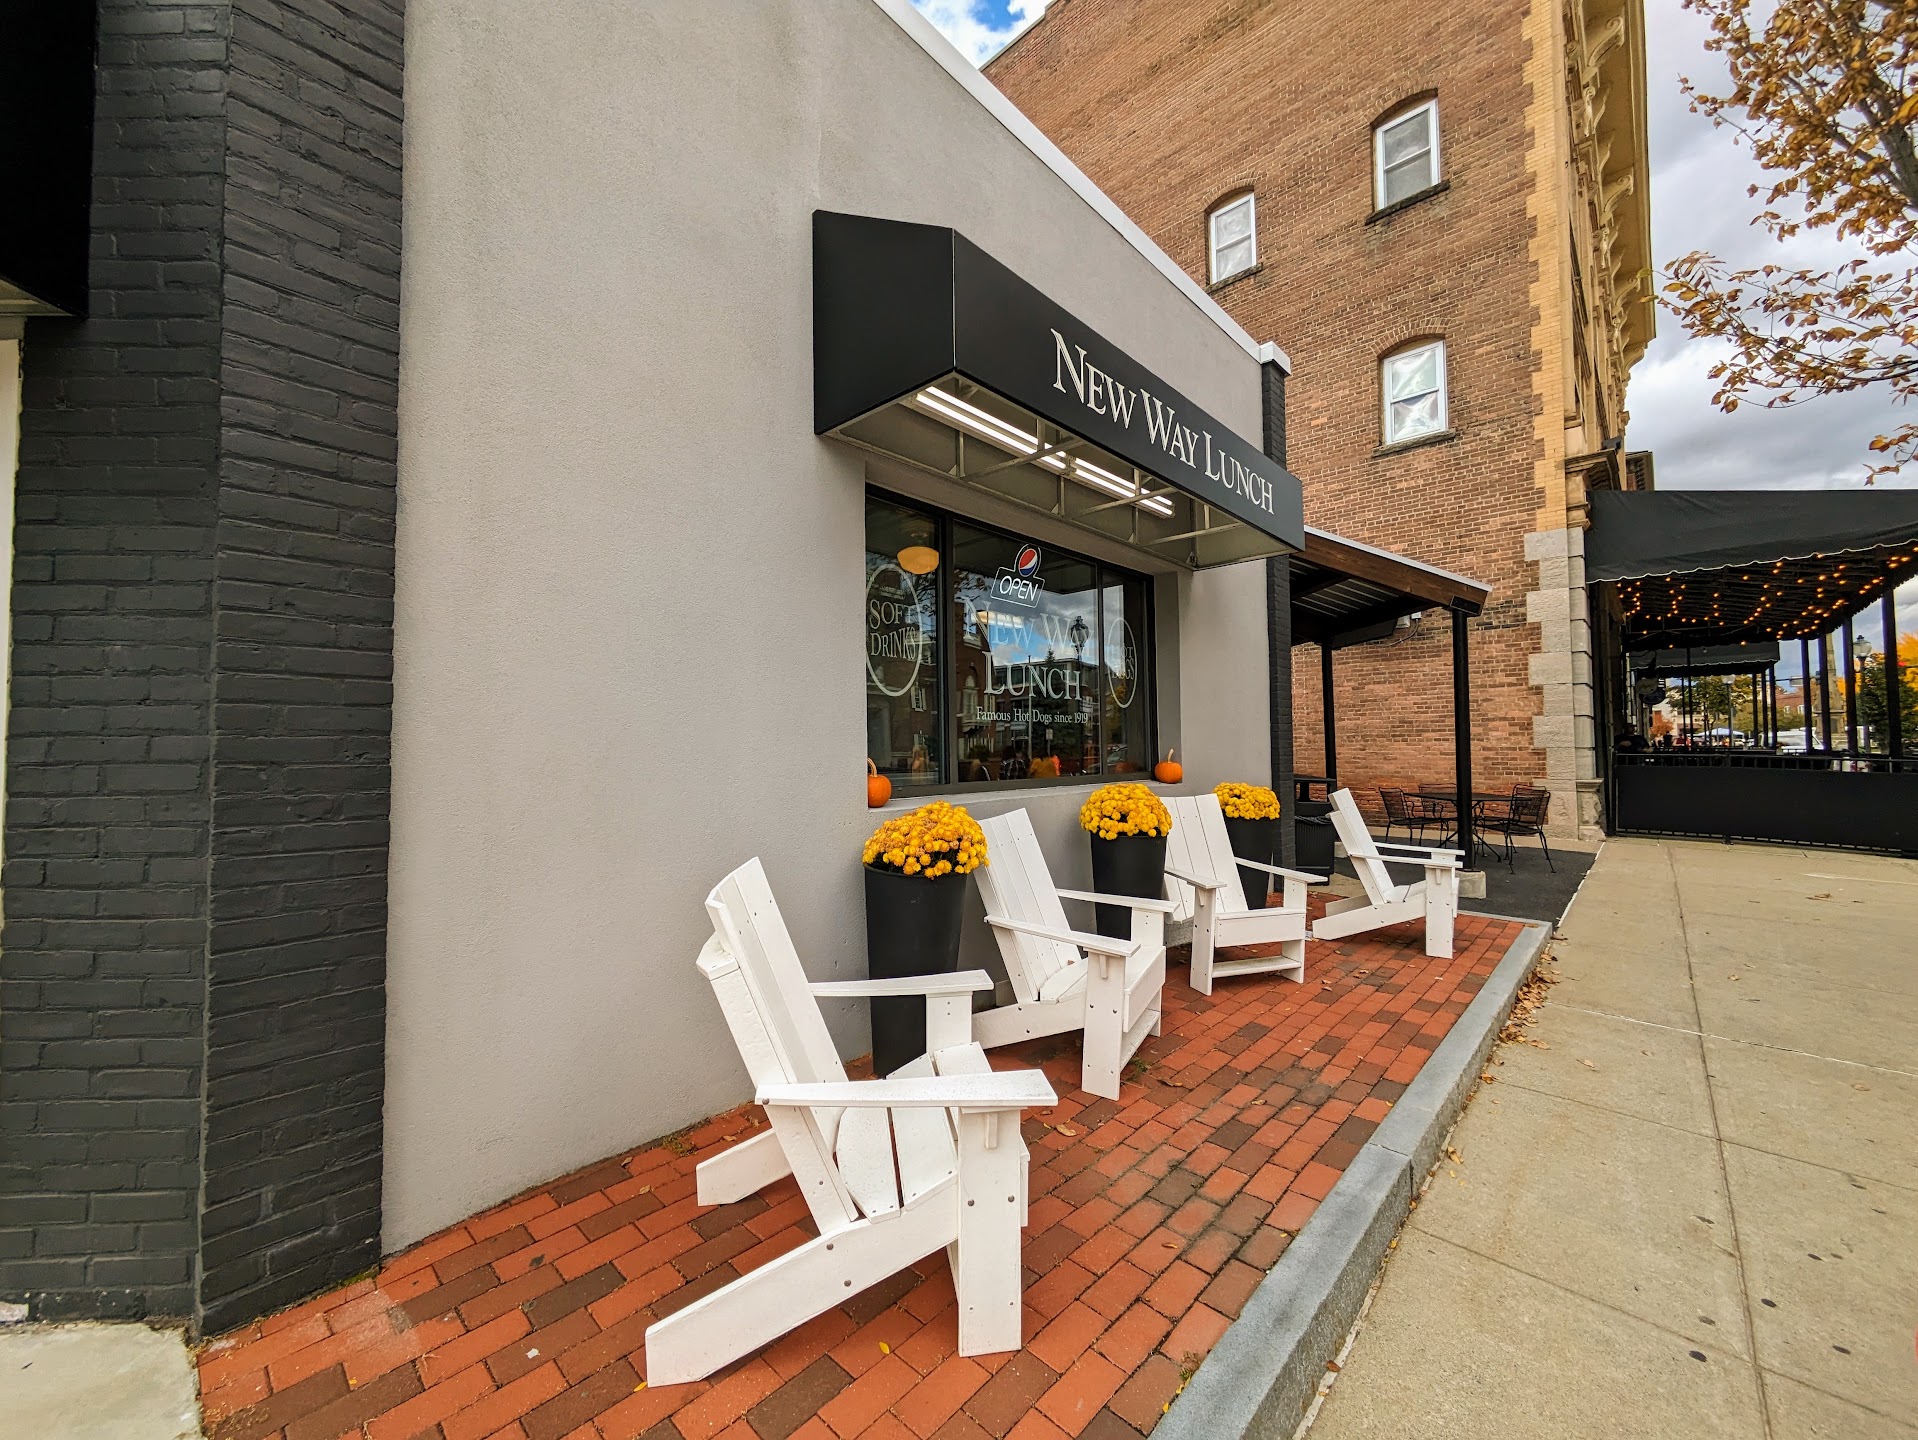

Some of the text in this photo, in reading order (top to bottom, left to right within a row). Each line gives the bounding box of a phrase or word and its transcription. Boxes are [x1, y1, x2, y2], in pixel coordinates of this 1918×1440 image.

[1050, 328, 1275, 515] NEW WAY LUNCH
[1000, 575, 1038, 601] OPEN
[870, 599, 915, 630] SOFT
[955, 596, 1036, 652] NEW
[870, 626, 916, 660] DRINKS
[982, 651, 1082, 700] LUNCH
[976, 706, 1088, 724] Famous Hot Dogs since 1919
